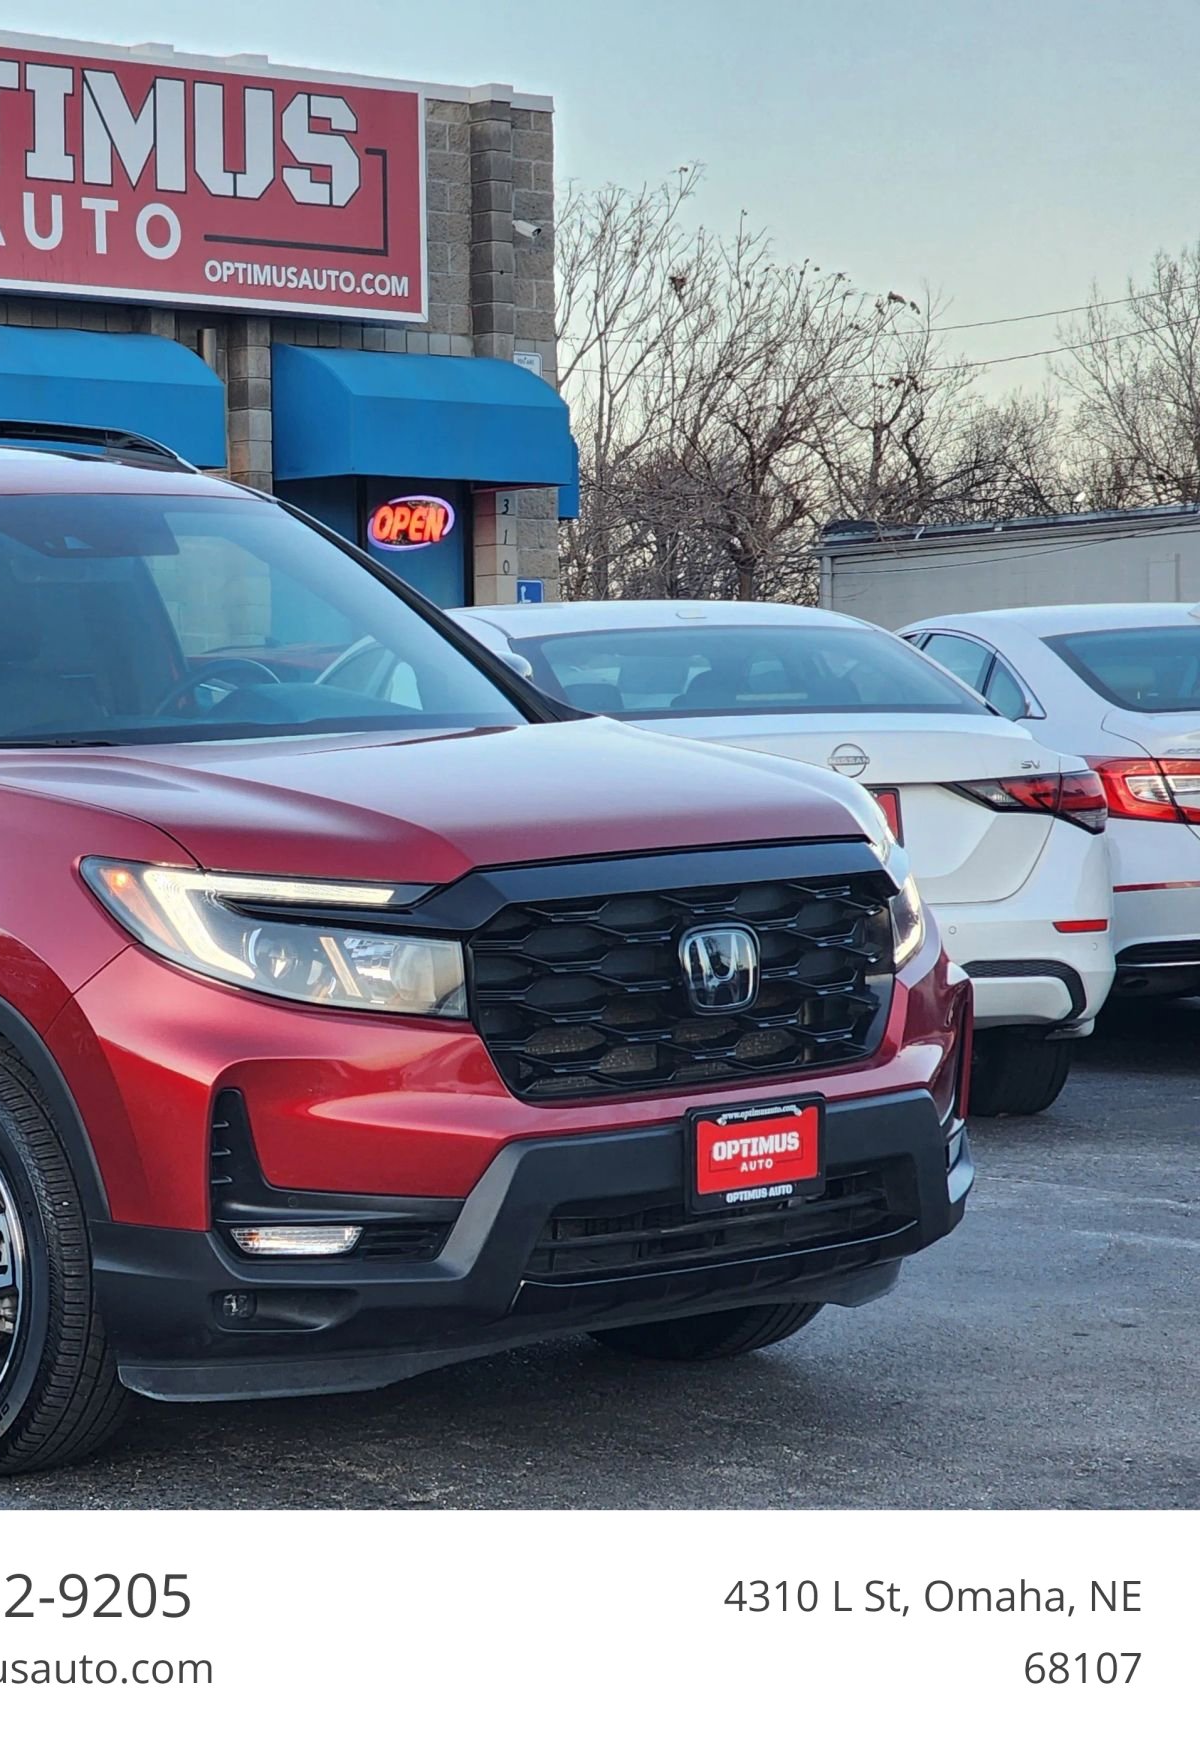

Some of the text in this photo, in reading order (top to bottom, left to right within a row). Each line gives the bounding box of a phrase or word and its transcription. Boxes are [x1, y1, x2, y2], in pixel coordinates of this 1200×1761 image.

[204, 260, 409, 298] OPTIMUSAUTO.COM
[372, 505, 446, 543] OPEN
[1021, 760, 1040, 769] SV
[721, 1104, 798, 1121] www.optimusauto.com
[712, 1131, 799, 1161] OPTIMUS
[740, 1158, 773, 1172] AUTO
[726, 1184, 793, 1203] OPTIMUS AUTO
